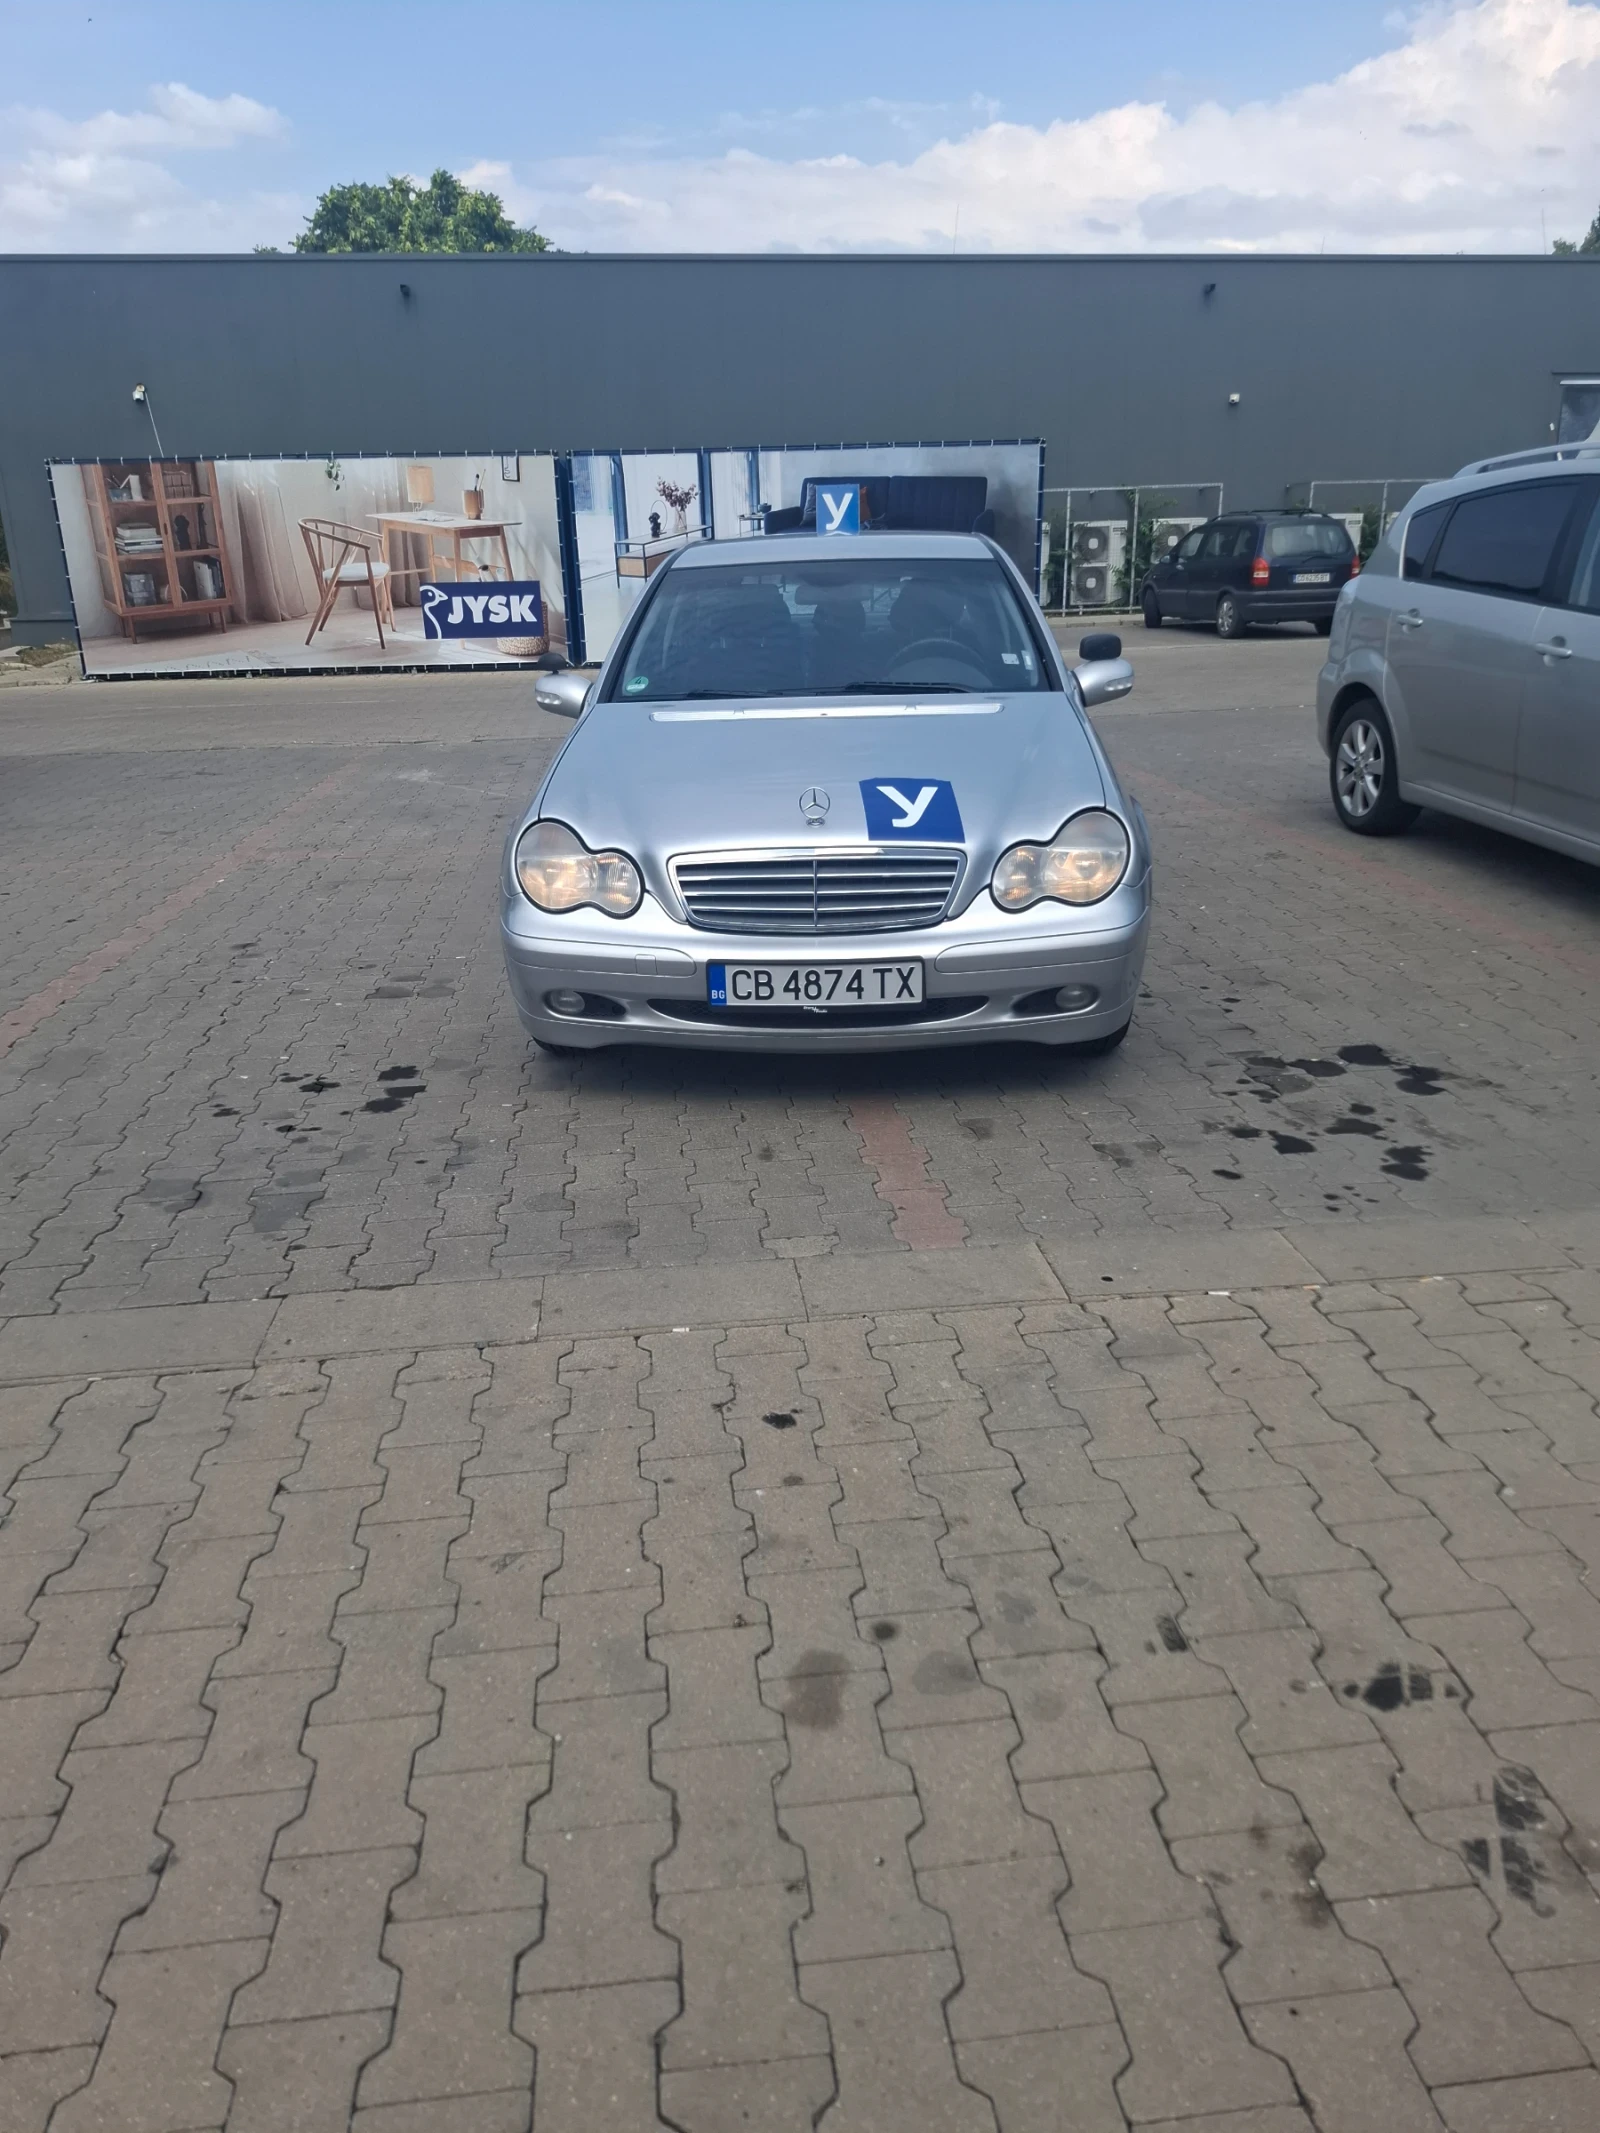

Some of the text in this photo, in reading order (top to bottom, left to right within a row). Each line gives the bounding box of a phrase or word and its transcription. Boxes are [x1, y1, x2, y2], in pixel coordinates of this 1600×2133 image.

[447, 595, 538, 624] JYSK
[711, 990, 725, 1000] BG
[731, 967, 915, 1000] CB 4874 TX
